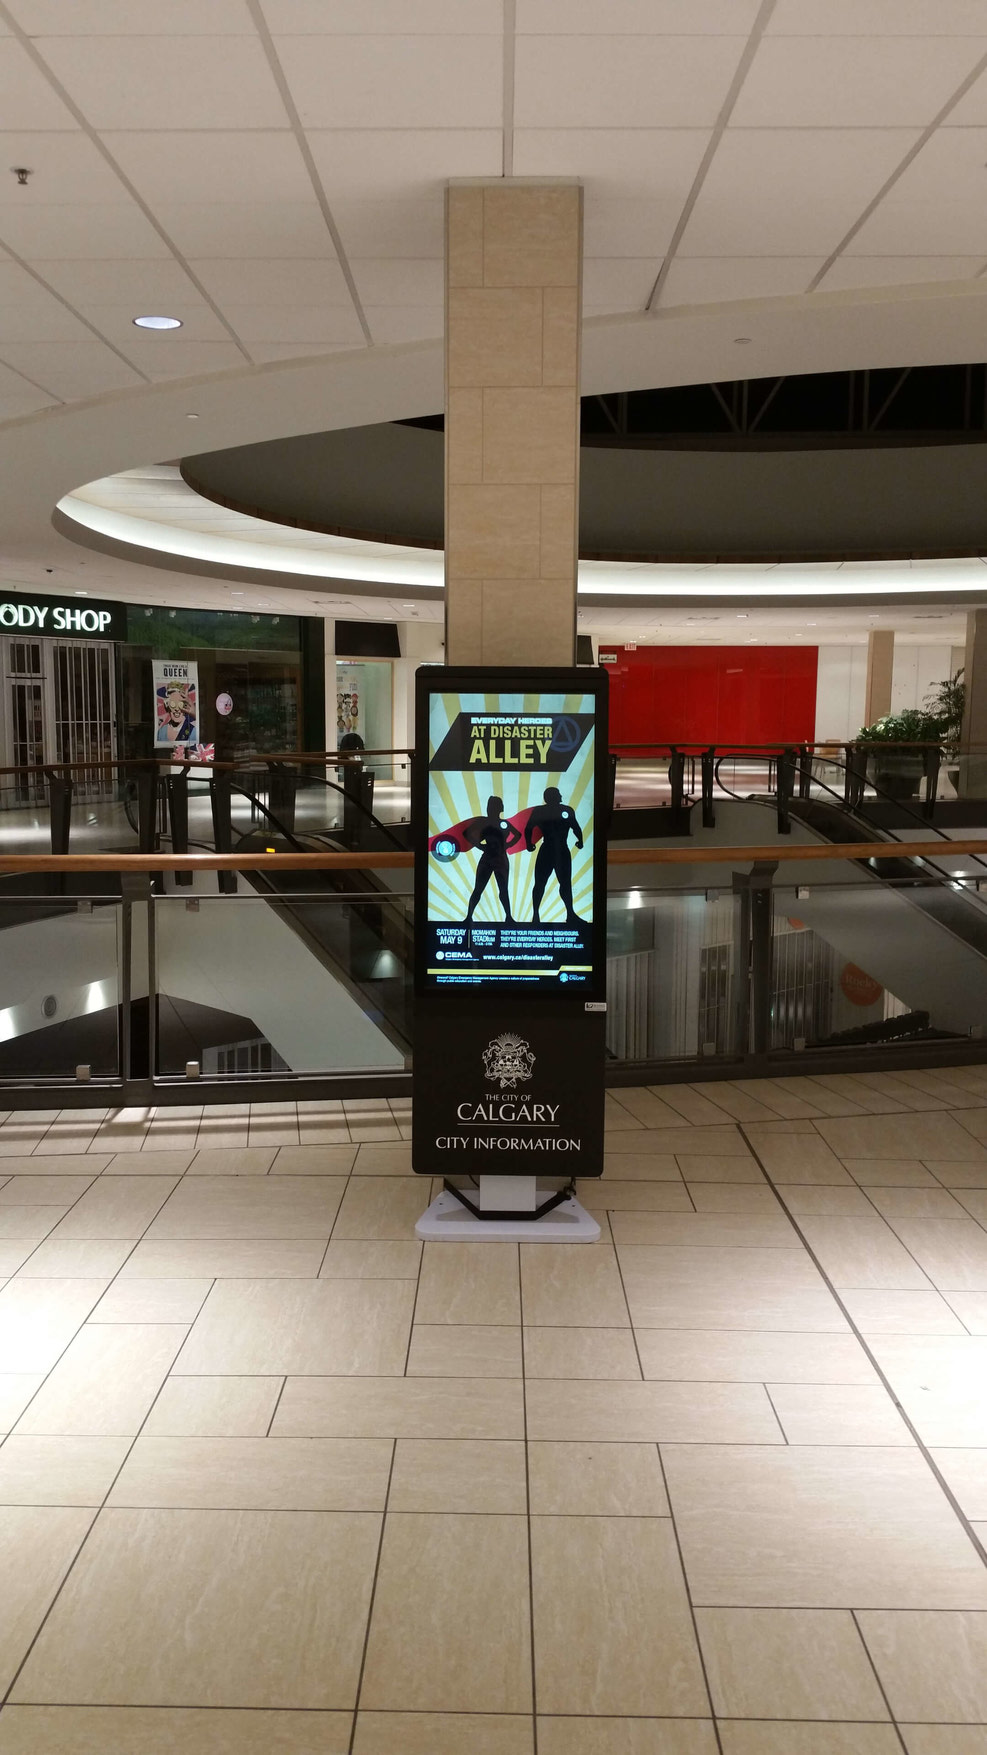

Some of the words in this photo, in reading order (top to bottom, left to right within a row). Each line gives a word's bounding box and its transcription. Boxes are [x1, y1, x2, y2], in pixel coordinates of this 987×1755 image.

[53, 607, 112, 632] SHOP
[163, 668, 188, 678] QUEEN
[470, 717, 517, 725] EVERYDAY
[517, 717, 553, 725] HEROES
[470, 726, 487, 738] AT
[490, 726, 553, 738] DISASTER
[469, 739, 553, 764] ALLEY
[436, 928, 467, 936] SATURDAY
[440, 936, 456, 944] MAY
[457, 936, 463, 944] 9
[457, 1103, 560, 1122] CALGARY
[435, 1136, 470, 1149] CITY
[473, 1137, 581, 1151] INFORMATION
